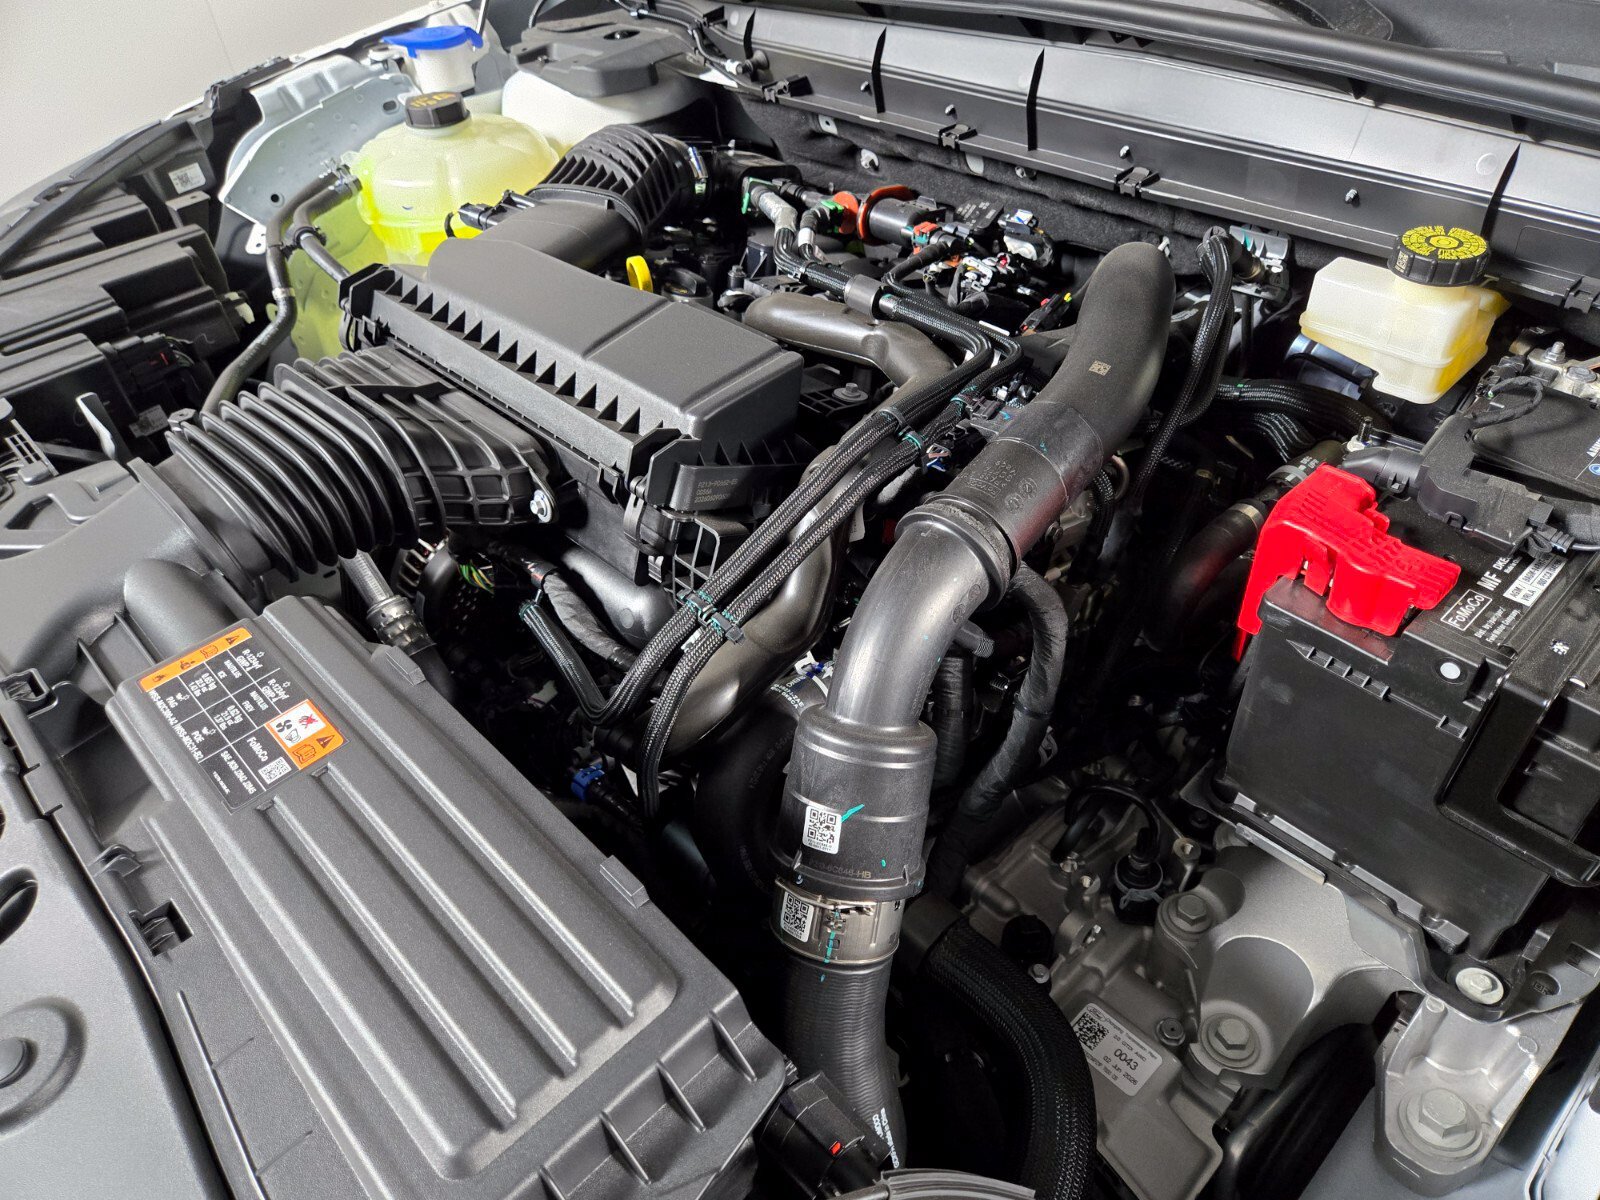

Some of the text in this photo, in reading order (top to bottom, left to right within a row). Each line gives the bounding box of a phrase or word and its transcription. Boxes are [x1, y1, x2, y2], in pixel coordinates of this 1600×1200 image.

[1476, 571, 1504, 591] MF
[1509, 587, 1523, 598] AGM
[1447, 593, 1485, 627] FoMoCo
[224, 660, 242, 678] NAUTILUS
[241, 649, 263, 670] R-1234yf
[266, 679, 289, 701] R-1234yf
[166, 696, 178, 708] PAG
[250, 691, 268, 710] NAUTILUS
[191, 731, 204, 743] POE
[221, 751, 232, 761] SAE
[247, 737, 271, 762] FoMoCo
[1113, 1048, 1139, 1071] 0043
[1112, 1063, 1123, 1073] Jun
[1122, 1072, 1138, 1086] 2026
